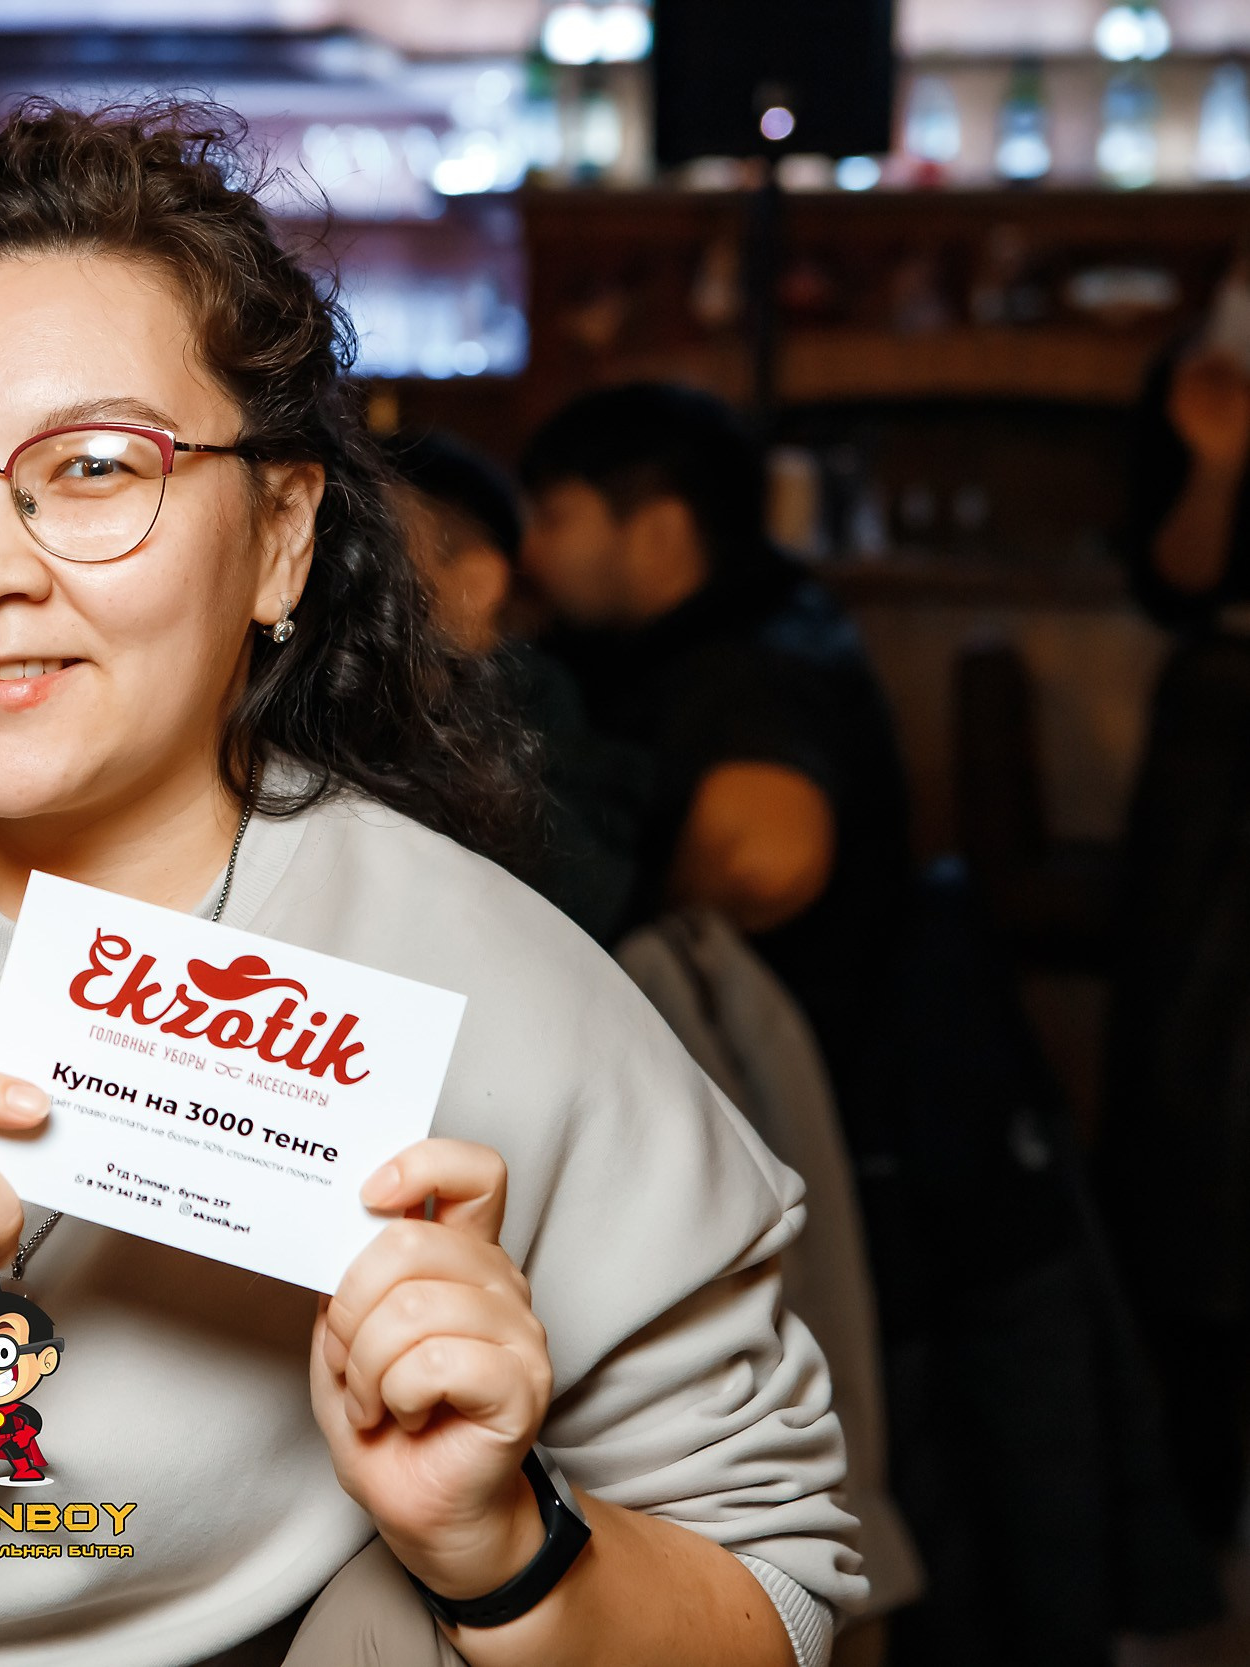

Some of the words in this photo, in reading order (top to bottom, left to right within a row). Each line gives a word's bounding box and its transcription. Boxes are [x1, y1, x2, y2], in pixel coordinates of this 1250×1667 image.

[68, 927, 371, 1086] Ekzotik
[89, 1024, 158, 1057] ГОЛОВНЫЕ
[163, 1045, 207, 1071] УБОРЫ
[246, 1071, 329, 1107] АКСЕССУАРЫ
[52, 1062, 138, 1103] Купон
[145, 1093, 178, 1115] на
[185, 1101, 254, 1136] 3000
[262, 1127, 338, 1162] тенге
[73, 1102, 107, 1118] право
[108, 1113, 148, 1131] оплаты
[150, 1126, 165, 1137] не
[167, 1129, 200, 1147] более
[202, 1139, 224, 1155] 50%
[226, 1148, 284, 1173] стоимости
[285, 1164, 332, 1186] покупки
